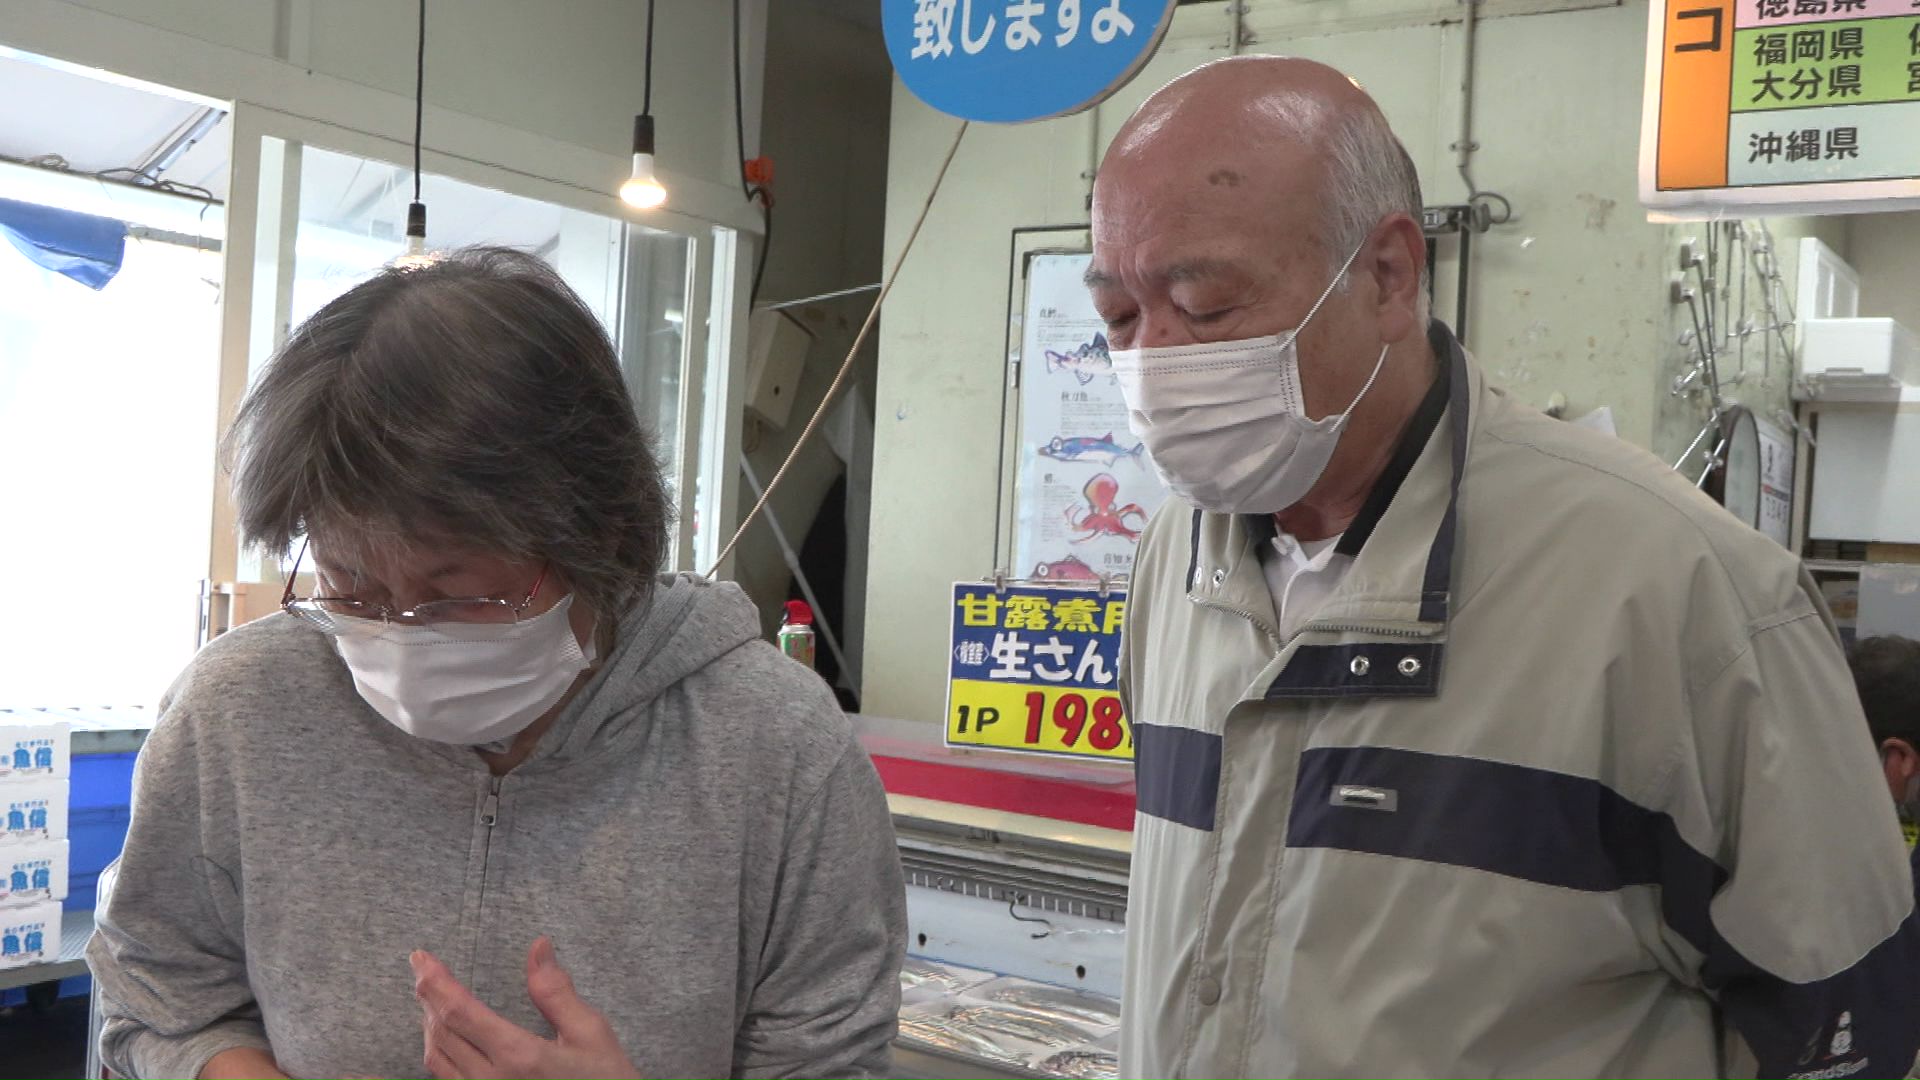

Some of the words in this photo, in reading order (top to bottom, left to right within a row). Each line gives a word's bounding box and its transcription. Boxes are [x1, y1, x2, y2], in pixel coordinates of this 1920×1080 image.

[1675, 8, 1723, 52] コ
[1753, 27, 1864, 66] 福岡県
[1751, 64, 1862, 103] 大分県
[1748, 127, 1859, 164] 沖縄県
[989, 631, 1121, 685] 生さん
[957, 705, 1000, 734] 1P
[1024, 691, 1124, 750] 198
